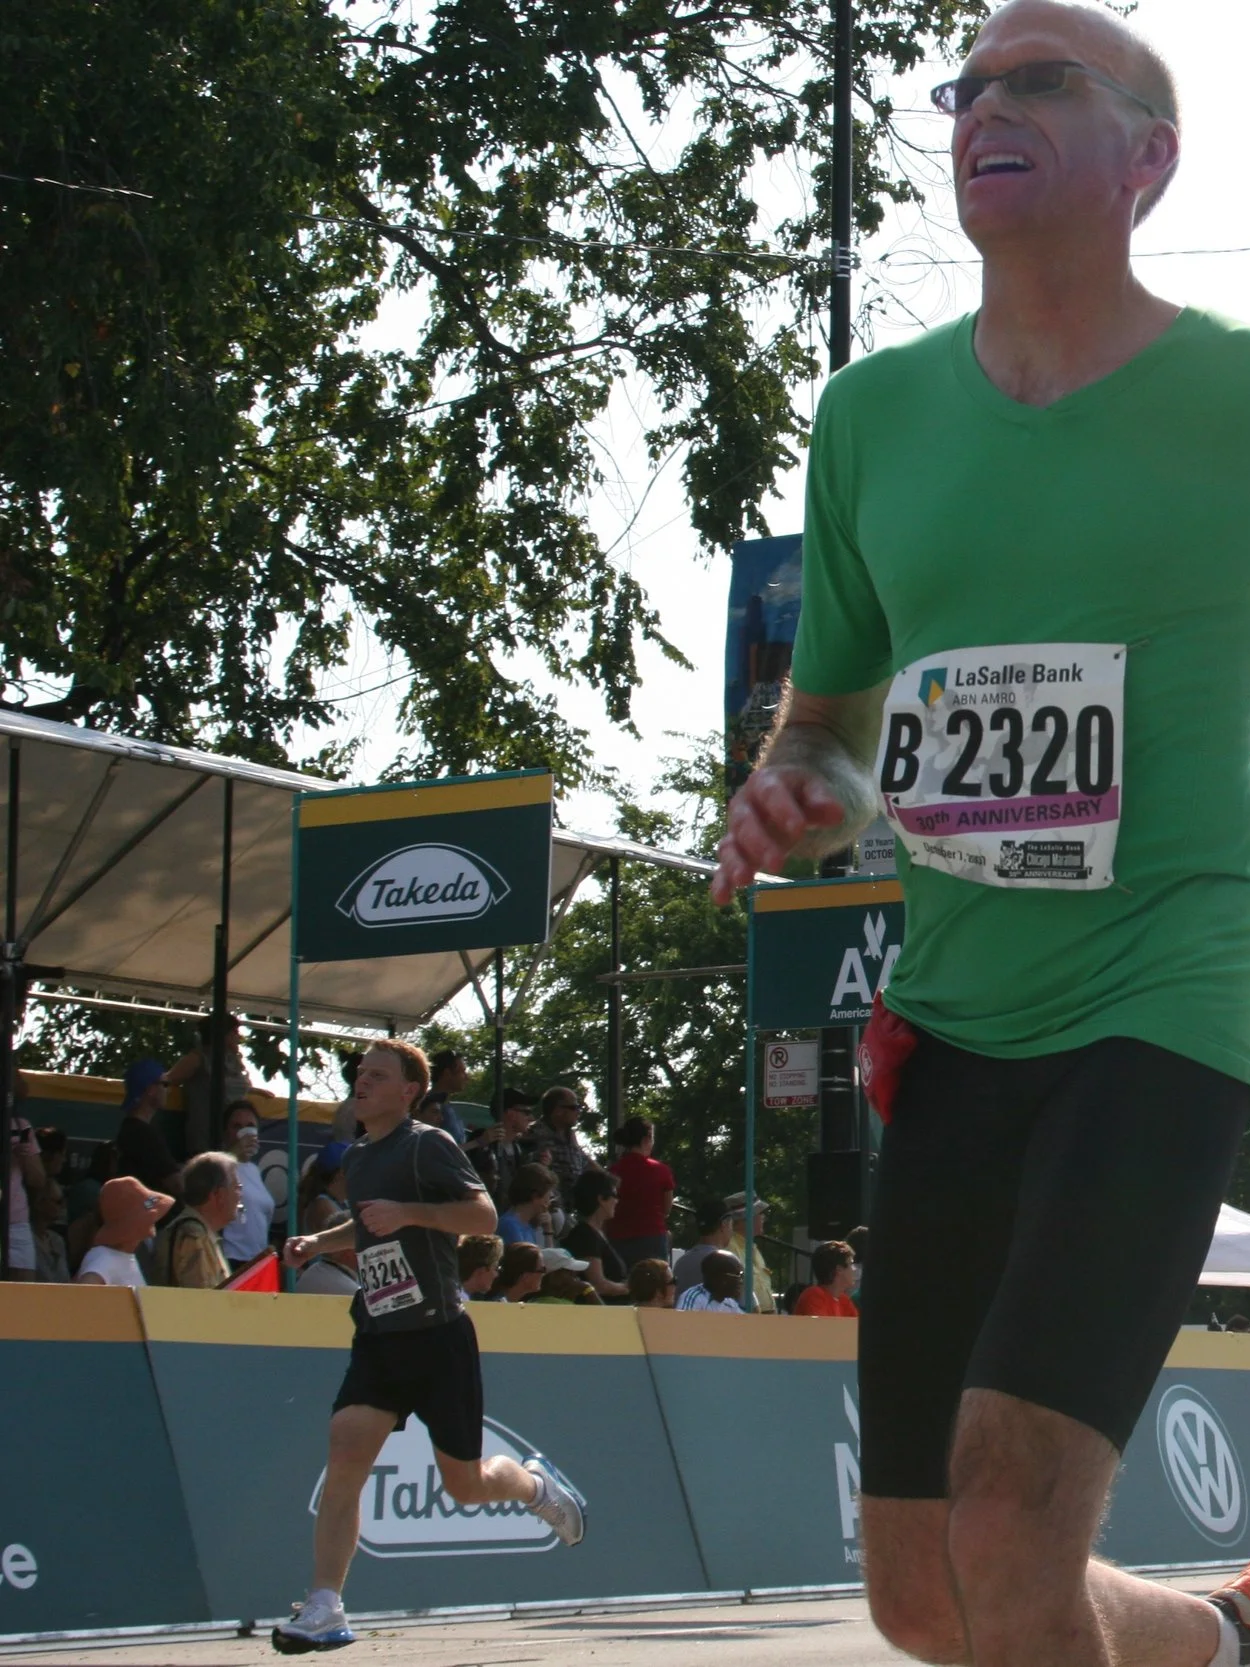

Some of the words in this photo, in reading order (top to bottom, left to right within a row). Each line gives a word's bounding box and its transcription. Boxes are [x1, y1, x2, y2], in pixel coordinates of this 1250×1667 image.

[955, 666, 1026, 687] LaSalle
[1032, 663, 1084, 683] Bank
[952, 695, 977, 706] ABN
[981, 692, 1016, 705] AMRO
[881, 712, 923, 793] B
[942, 704, 1114, 798] 2320
[916, 809, 950, 831] 30th
[956, 798, 1103, 828] ANNIVERSARY
[864, 849, 895, 860] OCTOB
[371, 872, 481, 910] Takeda
[368, 1256, 415, 1290] 3241
